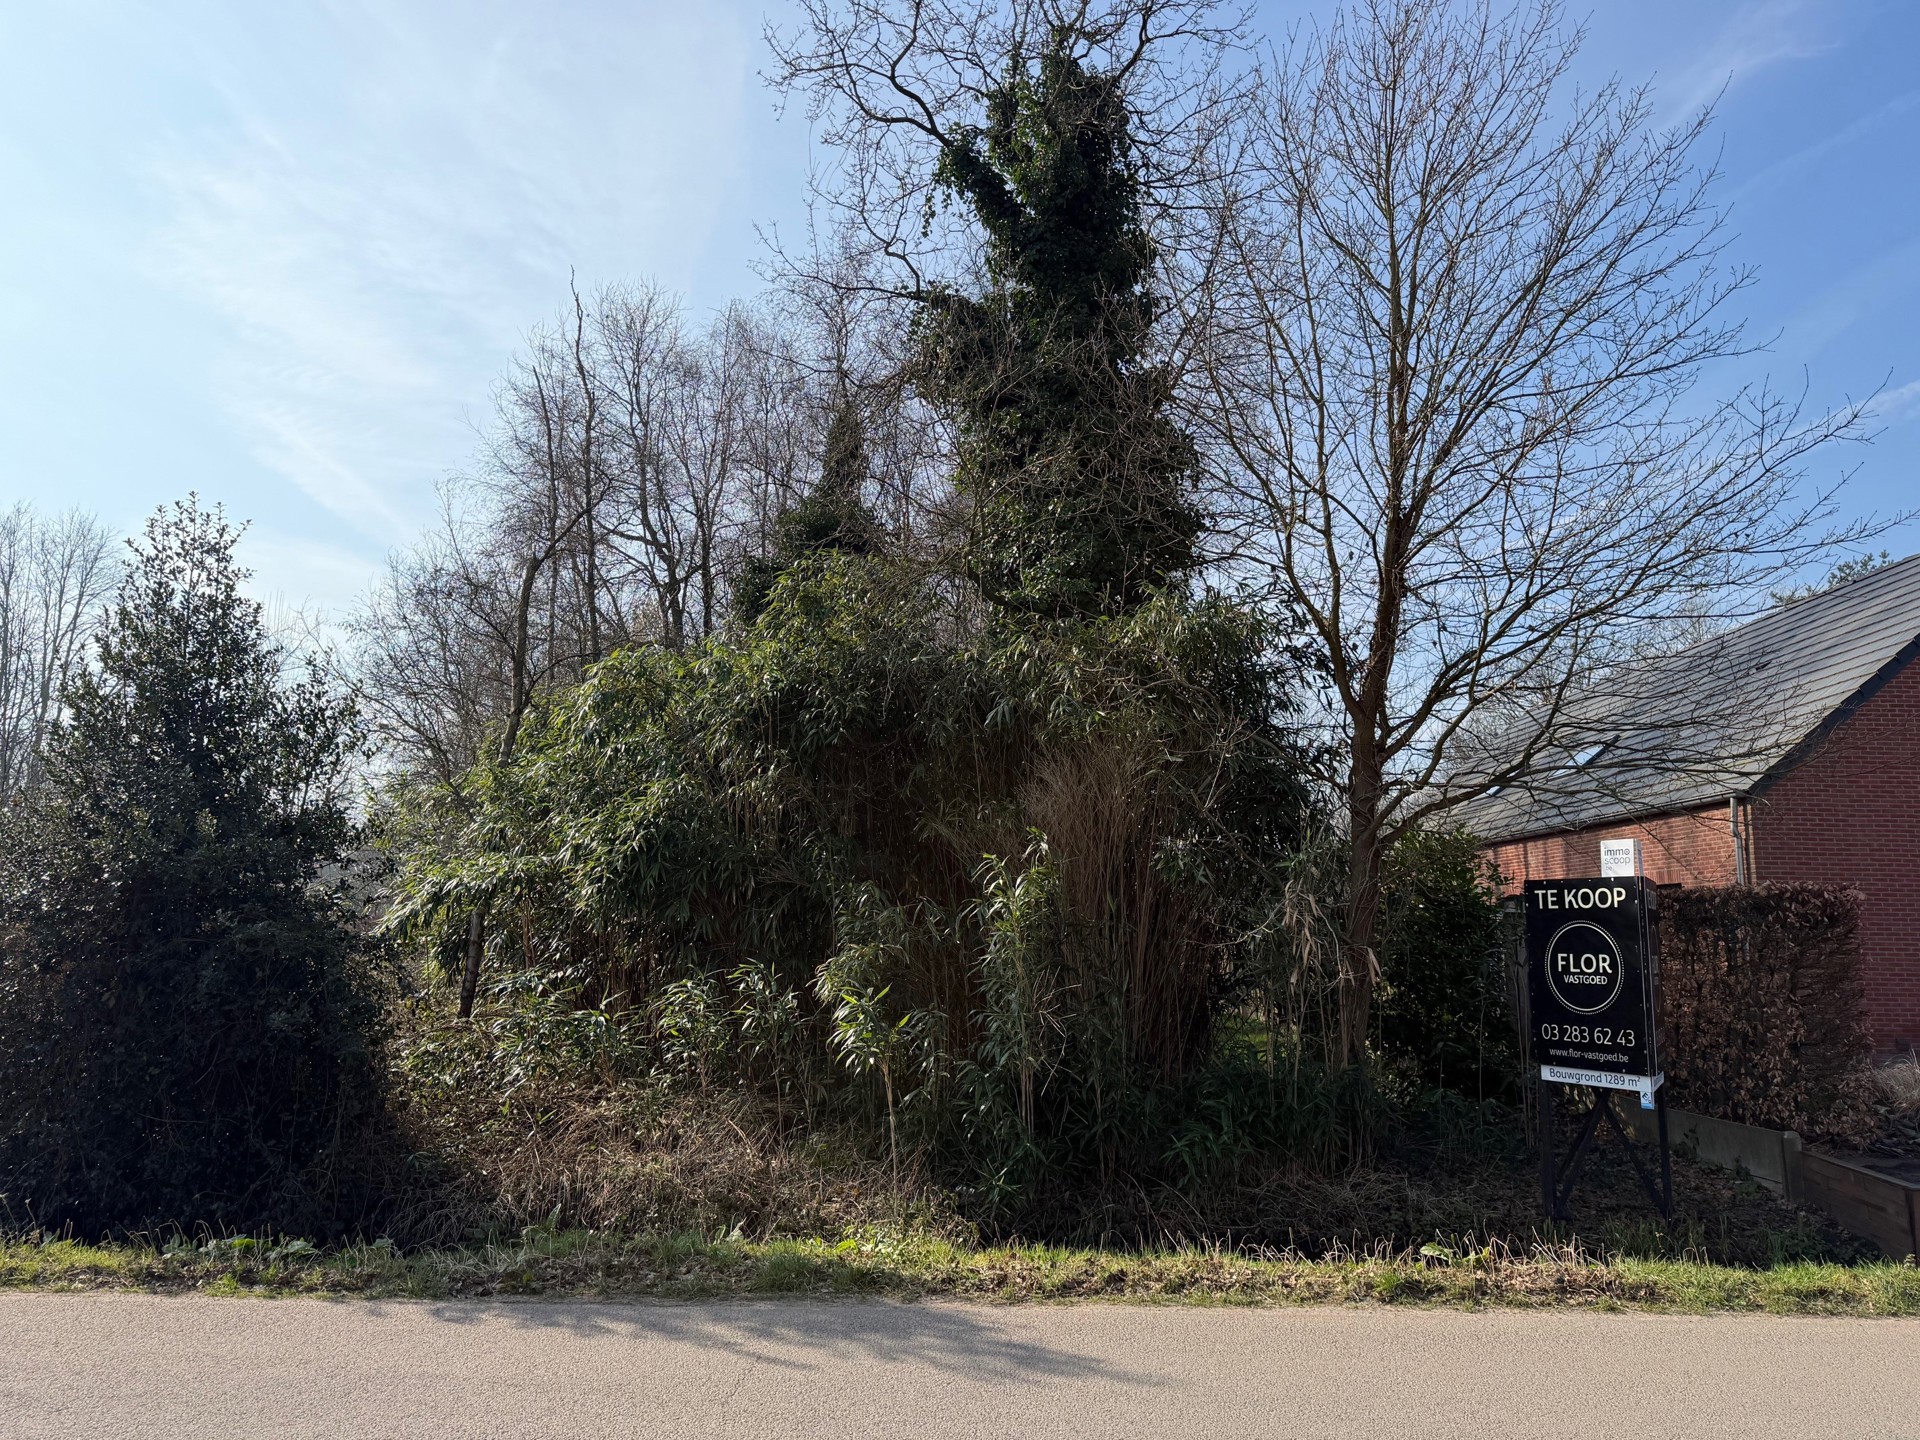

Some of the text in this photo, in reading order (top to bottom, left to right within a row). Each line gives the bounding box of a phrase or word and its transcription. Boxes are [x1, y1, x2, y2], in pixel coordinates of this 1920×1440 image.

[1604, 846, 1631, 857] immo
[1604, 857, 1631, 866] scoop
[1534, 889, 1559, 909] TE
[1564, 887, 1627, 909] KOOP
[1557, 953, 1612, 974] FLOR
[1563, 974, 1608, 985] VASTGOED
[1541, 1023, 1560, 1041] 03
[1563, 1025, 1590, 1043] 283
[1594, 1027, 1613, 1045] 62
[1616, 1029, 1635, 1047] 43
[1549, 1048, 1629, 1063] www.flor-vastgoed.be
[1550, 1067, 1602, 1084] Bouwgrond
[1604, 1073, 1626, 1086] 1289
